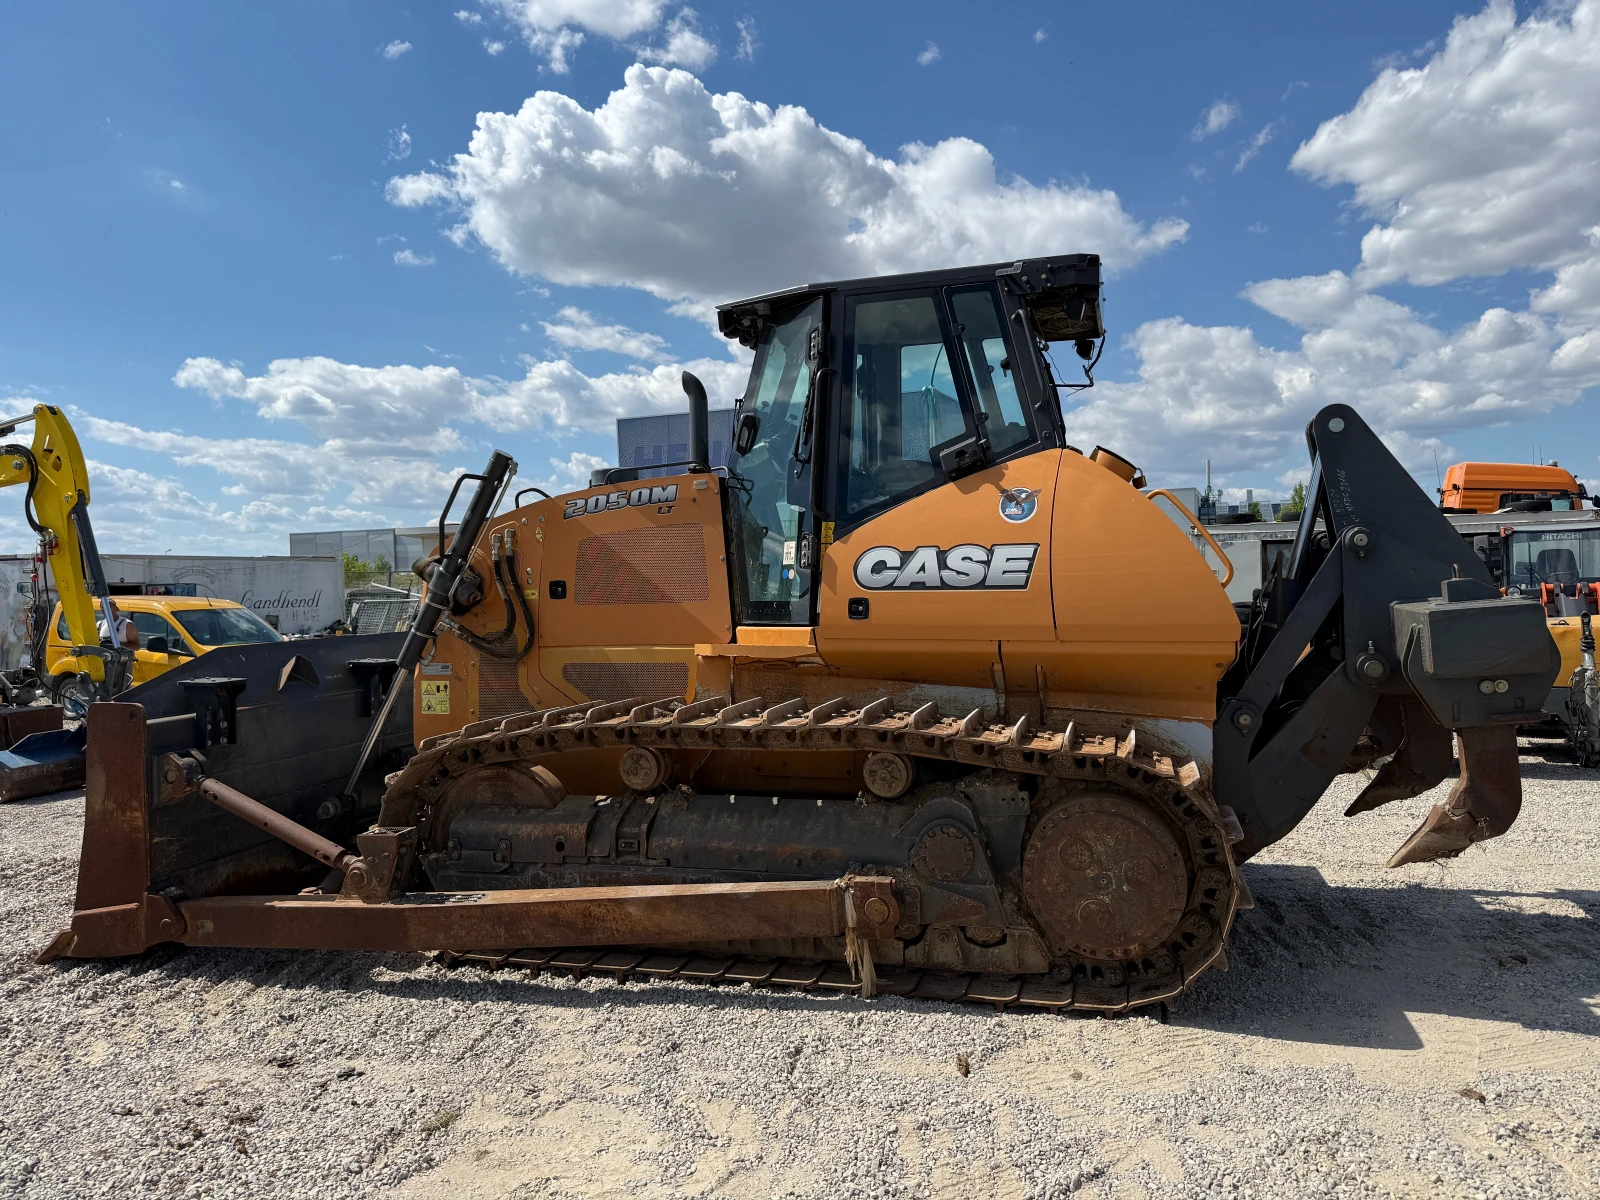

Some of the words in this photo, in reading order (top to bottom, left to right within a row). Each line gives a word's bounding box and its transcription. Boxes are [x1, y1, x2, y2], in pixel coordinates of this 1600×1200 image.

[563, 484, 679, 520] 2050M
[657, 505, 676, 515] LT
[853, 543, 1040, 590] CASE
[240, 590, 324, 609] Landhendl
